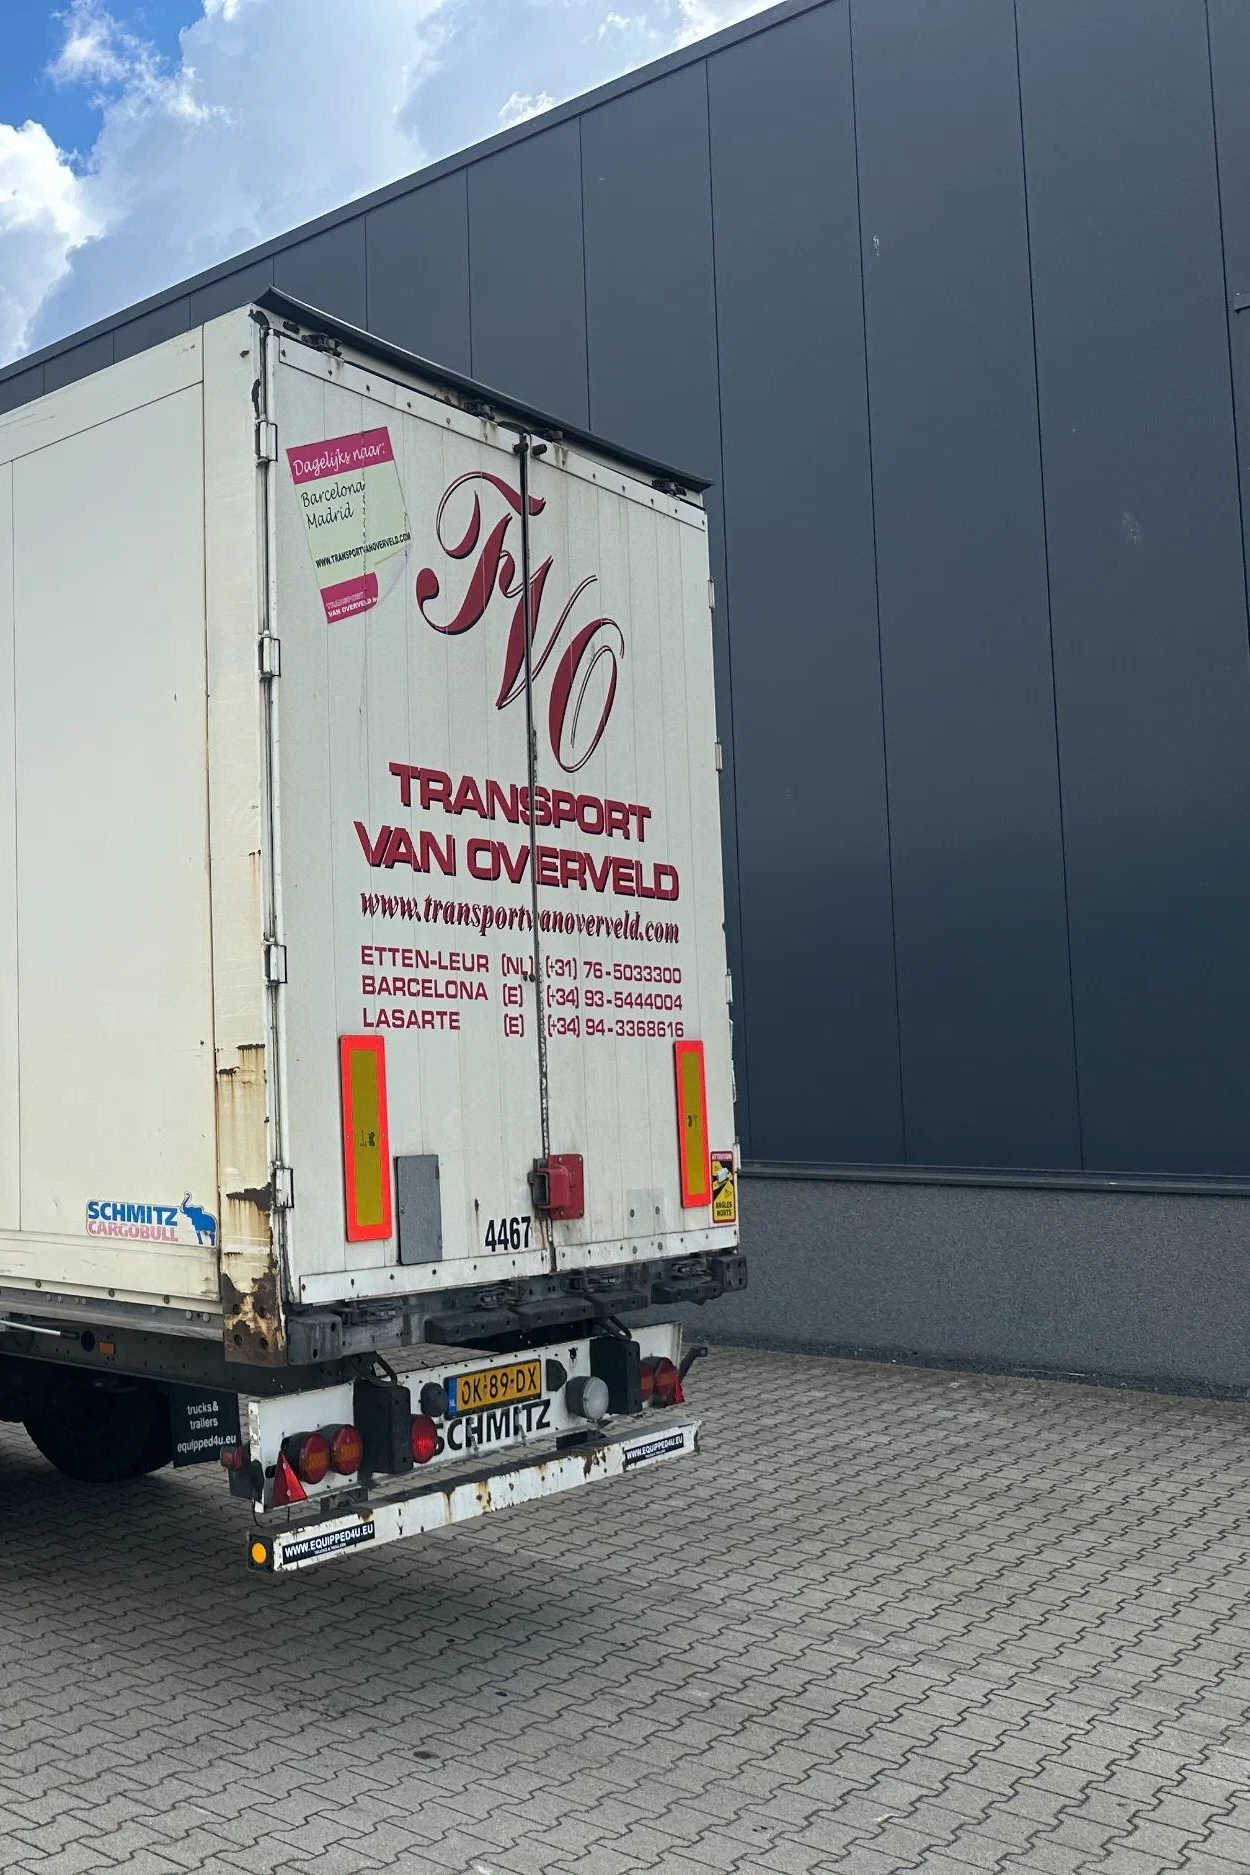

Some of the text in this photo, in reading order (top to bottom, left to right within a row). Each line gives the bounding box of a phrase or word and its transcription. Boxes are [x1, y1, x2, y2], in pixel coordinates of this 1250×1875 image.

[292, 442, 386, 477] Dagelijks naar:
[300, 481, 366, 508] Barcelona
[305, 501, 355, 530] Madrid
[315, 532, 412, 568] WWW.TRANSPORTVANOVERVELD.COM
[327, 608, 342, 618] VAN
[388, 761, 652, 843] TRANSPORT
[352, 820, 680, 902] VAN OVERVELD
[359, 891, 680, 945] www.transportvanoverveld.com
[360, 944, 490, 973] ETTEN-LEUR
[545, 954, 578, 981] (+31)
[361, 975, 490, 1001] BARCELONA
[502, 983, 524, 1008] (E)
[546, 985, 580, 1010] (+34)
[362, 1006, 461, 1031] LASARTE
[503, 1013, 525, 1038] (E)
[547, 1013, 581, 1038] (+34)
[87, 1201, 178, 1227] SCHMITZ
[87, 1220, 179, 1243] CARGOBULL
[484, 1215, 531, 1253] 4467
[461, 1366, 537, 1405] OK-89-DX
[189, 1418, 219, 1430] trailers
[176, 1434, 237, 1454] equipped4u.eu
[626, 1435, 683, 1460] WWW.EQUIPPED4U.EU
[284, 1523, 374, 1558] WWW.EQUIPPED4U.EU
